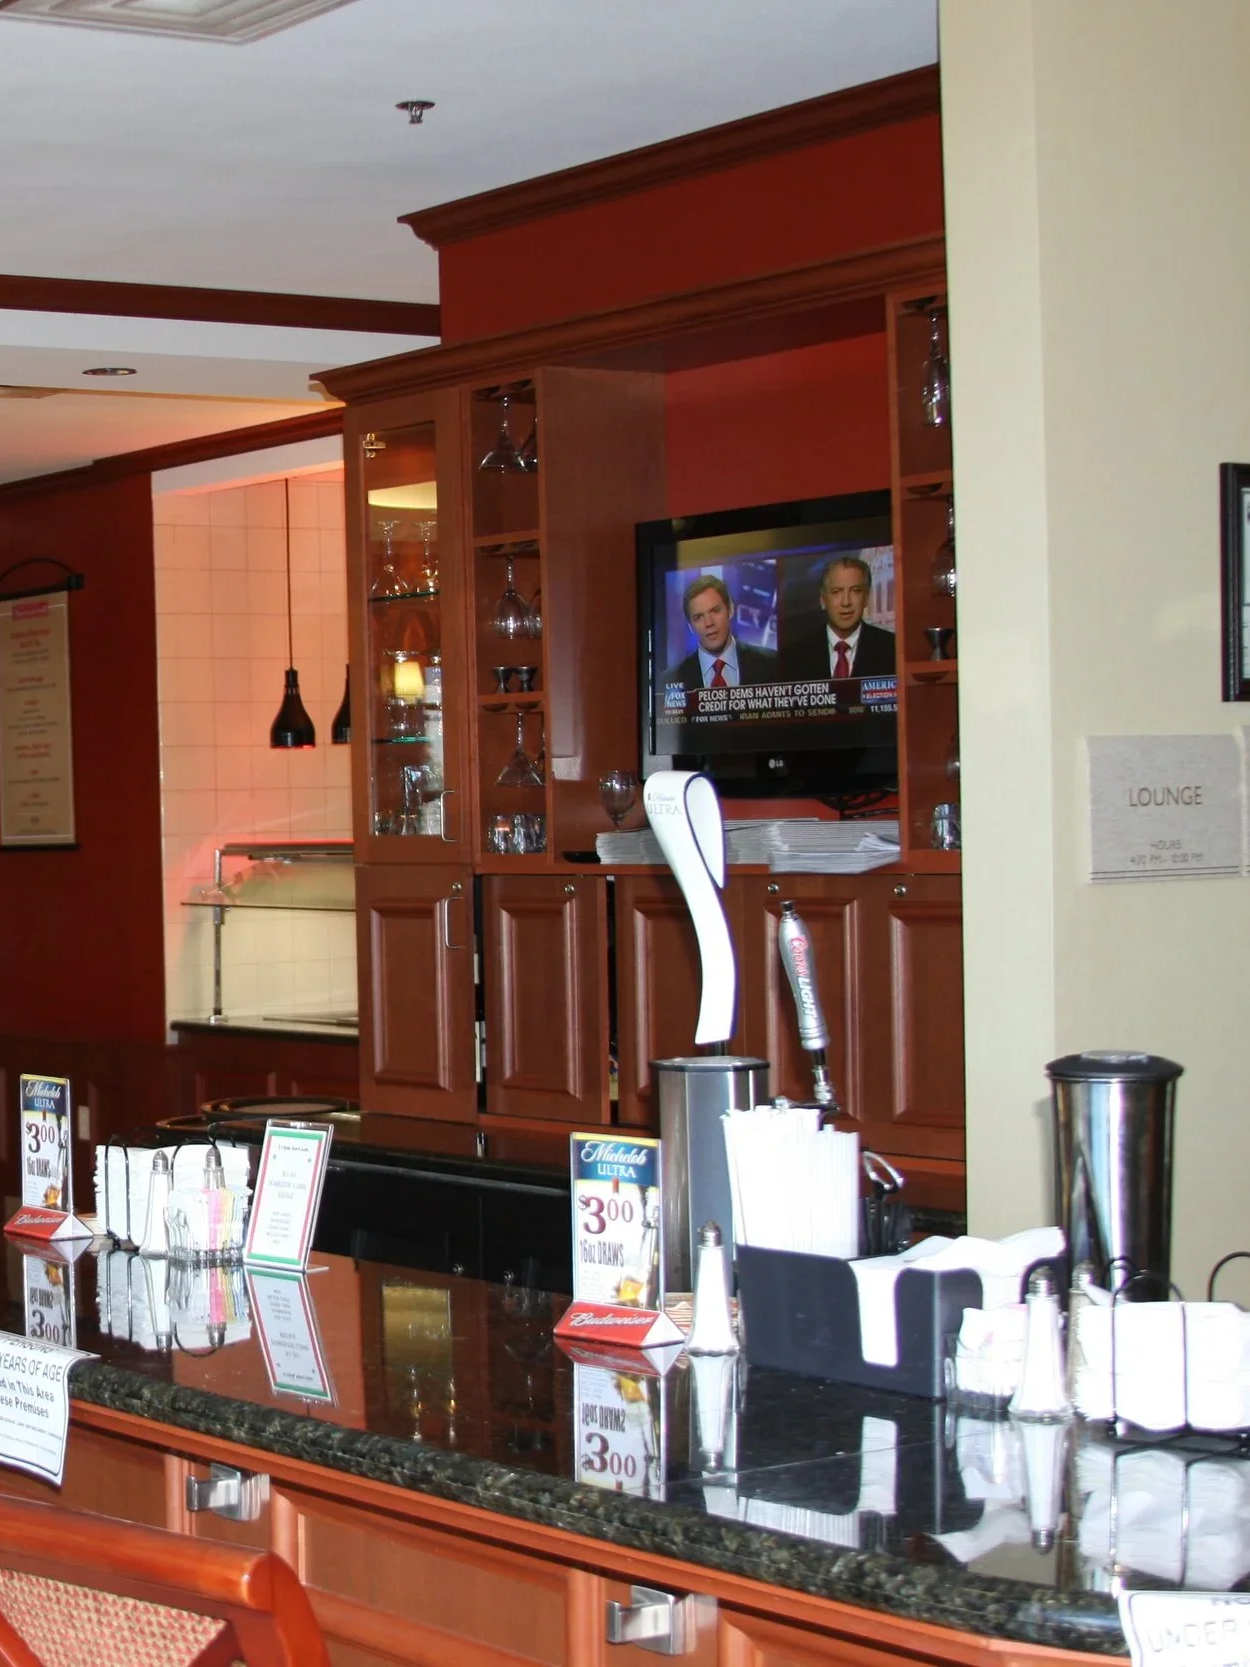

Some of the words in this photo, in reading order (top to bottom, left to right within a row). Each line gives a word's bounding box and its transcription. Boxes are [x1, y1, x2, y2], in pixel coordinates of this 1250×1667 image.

[670, 692, 685, 700] FOX
[698, 690, 728, 701] PELOSI:
[730, 688, 753, 699] DEMS
[755, 685, 792, 698] HAVEN'T
[794, 682, 829, 695] GOTTEN
[668, 700, 686, 708] NEWS
[698, 700, 727, 712] CREDIT
[729, 700, 746, 711] FOR
[747, 698, 773, 710] WHAT
[774, 695, 808, 708] THEY'VE
[810, 694, 837, 705] DONE
[695, 715, 708, 723] FOX
[794, 709, 805, 717] TO
[1128, 786, 1203, 807] LOUNGE
[798, 975, 817, 1020] LIGHT
[34, 1098, 55, 1110] ULTRA
[580, 1141, 648, 1166] Michelob
[597, 1164, 637, 1178] ULTRA
[580, 1238, 596, 1264] 16oz
[597, 1240, 624, 1268] DRAWS
[569, 1312, 656, 1327] Budweiser
[0, 1352, 28, 1374] YEARS
[29, 1359, 42, 1376] OF
[42, 1363, 62, 1382] AGE
[9, 1377, 16, 1390] in
[16, 1380, 34, 1397] This
[36, 1387, 55, 1402] Area
[14, 1396, 50, 1419] Premises
